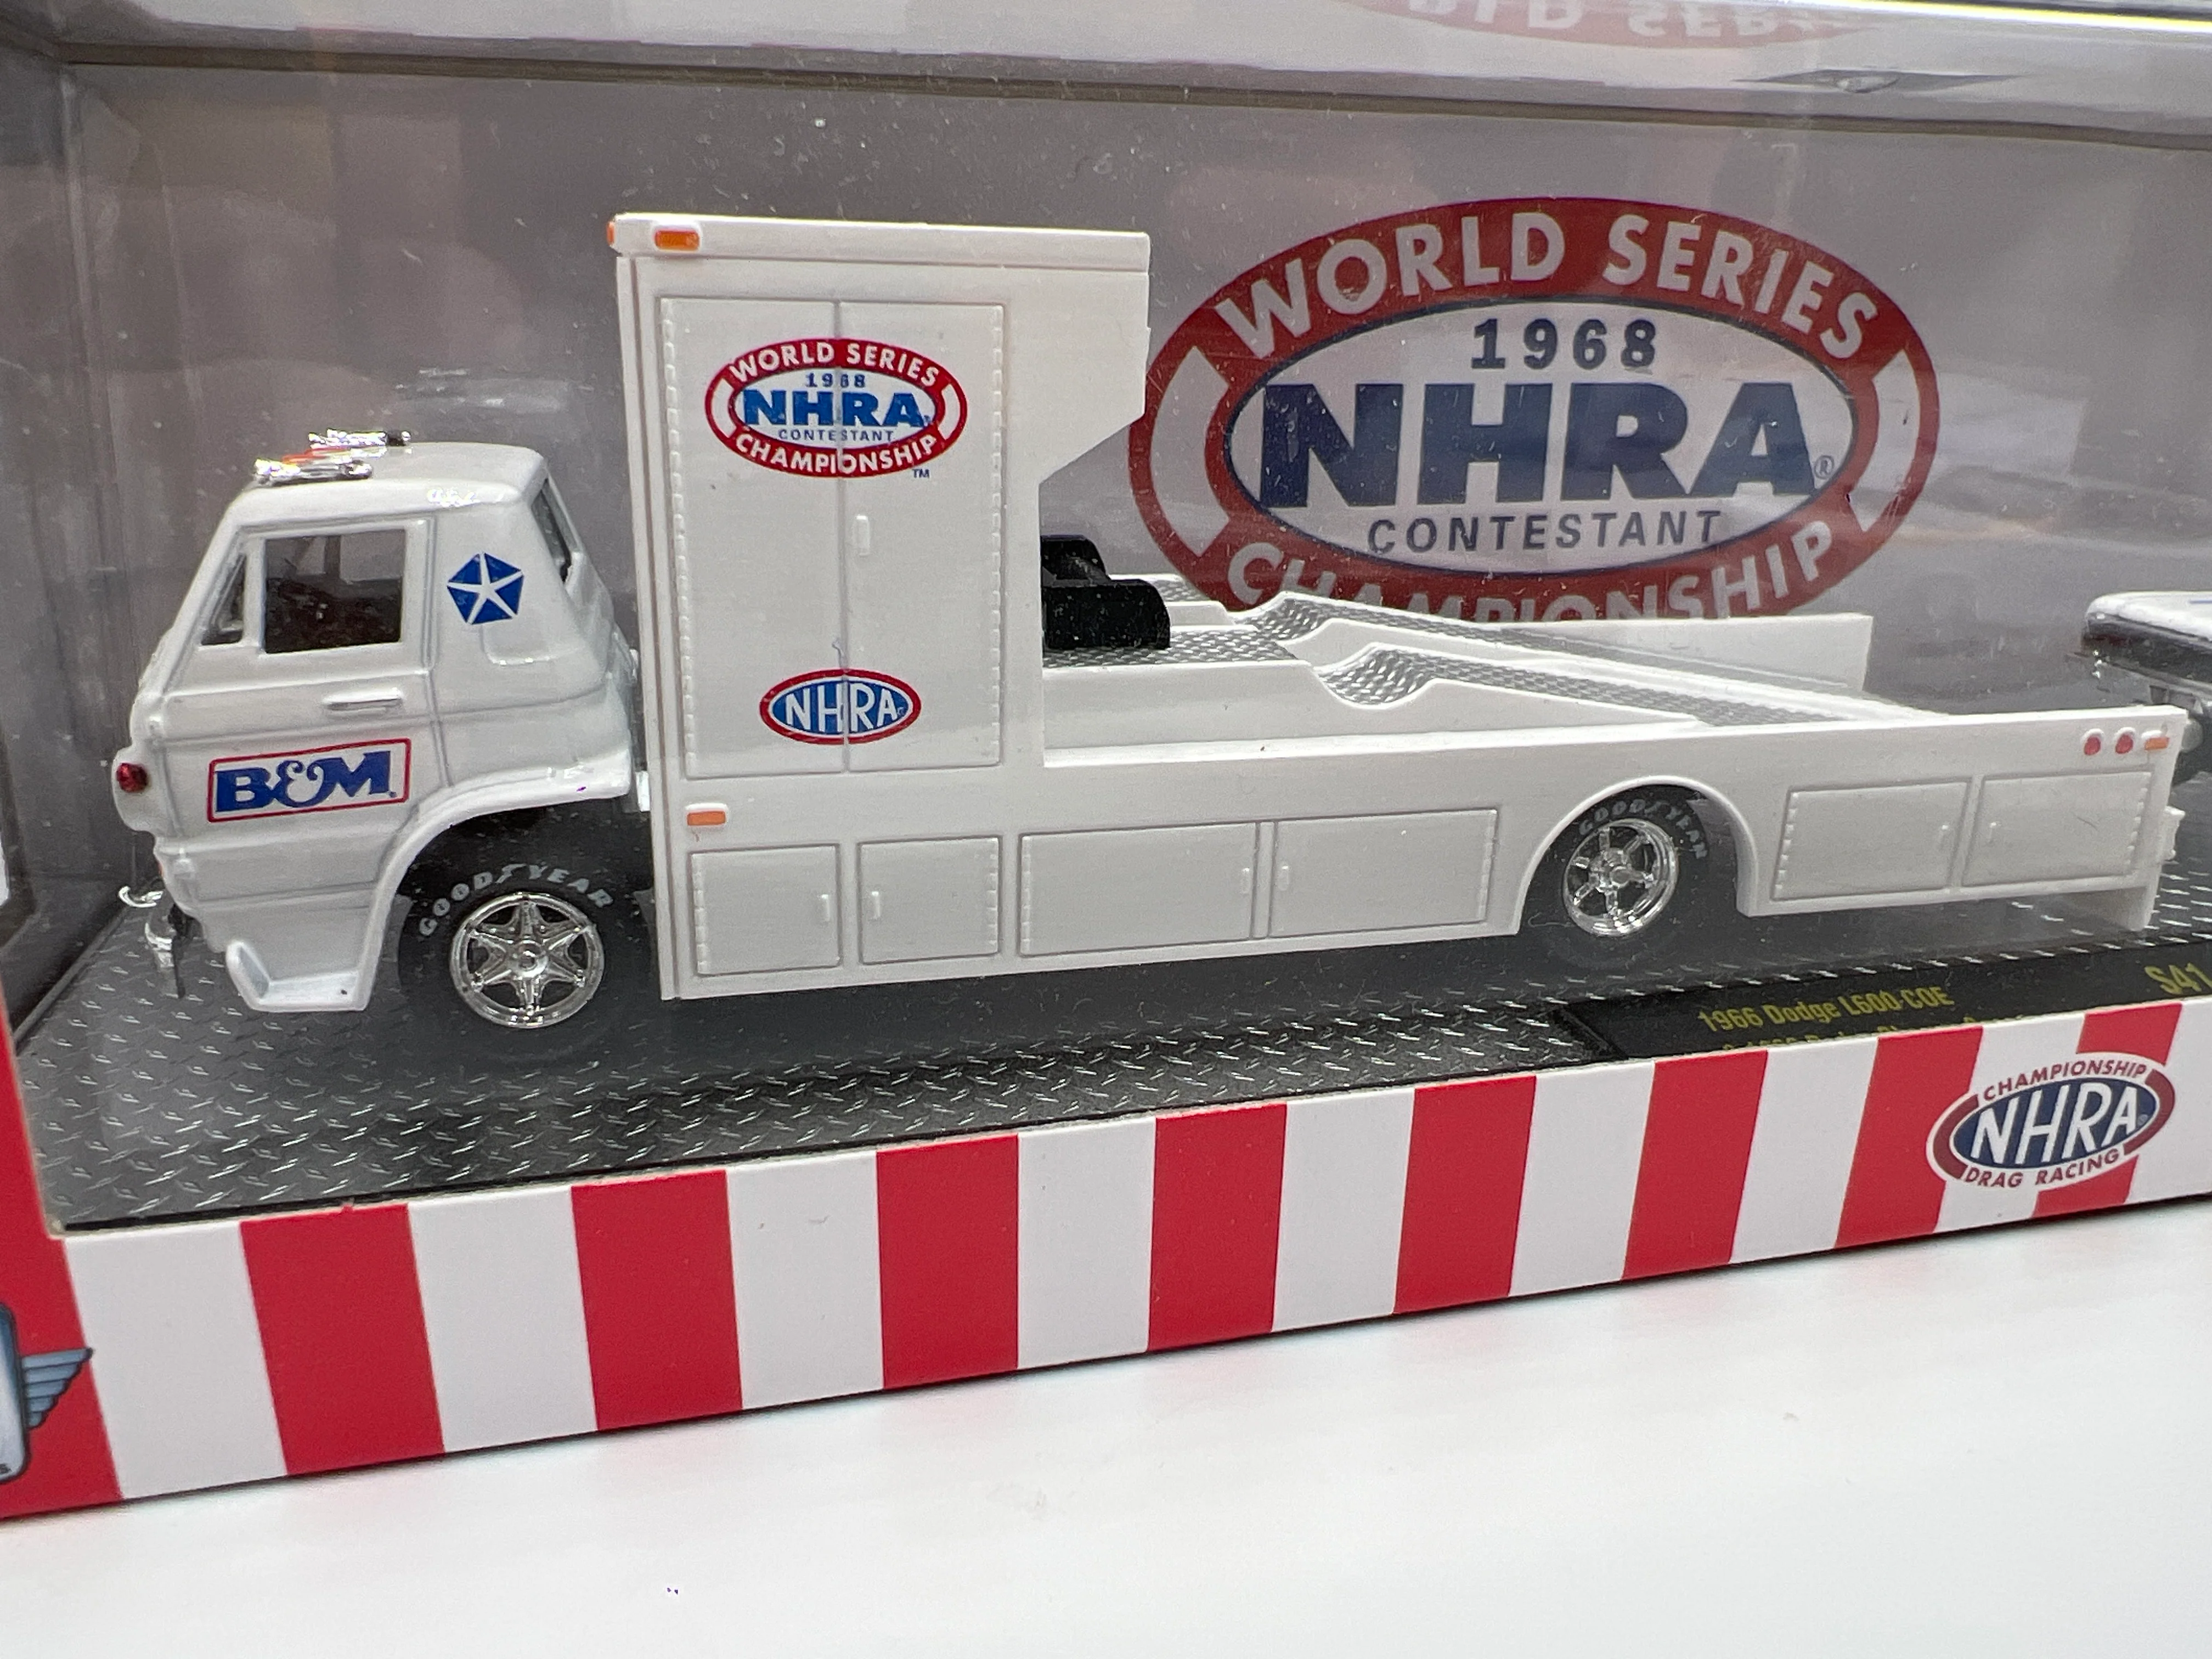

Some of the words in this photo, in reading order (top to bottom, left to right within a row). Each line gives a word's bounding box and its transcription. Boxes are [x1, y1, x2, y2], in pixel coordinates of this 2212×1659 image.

[1217, 212, 1565, 359] WORLD
[1604, 213, 1878, 359] SERIES
[729, 342, 834, 382] WORLD
[847, 343, 940, 386] SERIES
[1471, 318, 1657, 370] 1968
[736, 433, 937, 474] CHAMPIONSHIP
[778, 429, 894, 442] CONTESTANT
[1368, 509, 1721, 553] CONTESTANT
[786, 682, 898, 732] NHRA
[216, 750, 391, 812] B&M
[1698, 1007, 1764, 1032] 1966
[1762, 1001, 1842, 1024] Dodge
[1837, 990, 1902, 1015] L600
[1900, 986, 1955, 1009] COE
[1983, 1059, 2147, 1102] CHAMPIONSHIP
[1970, 1082, 2137, 1165] NHRA
[1963, 1166, 2024, 1189] DRAG
[2034, 1148, 2120, 1187] RACING
